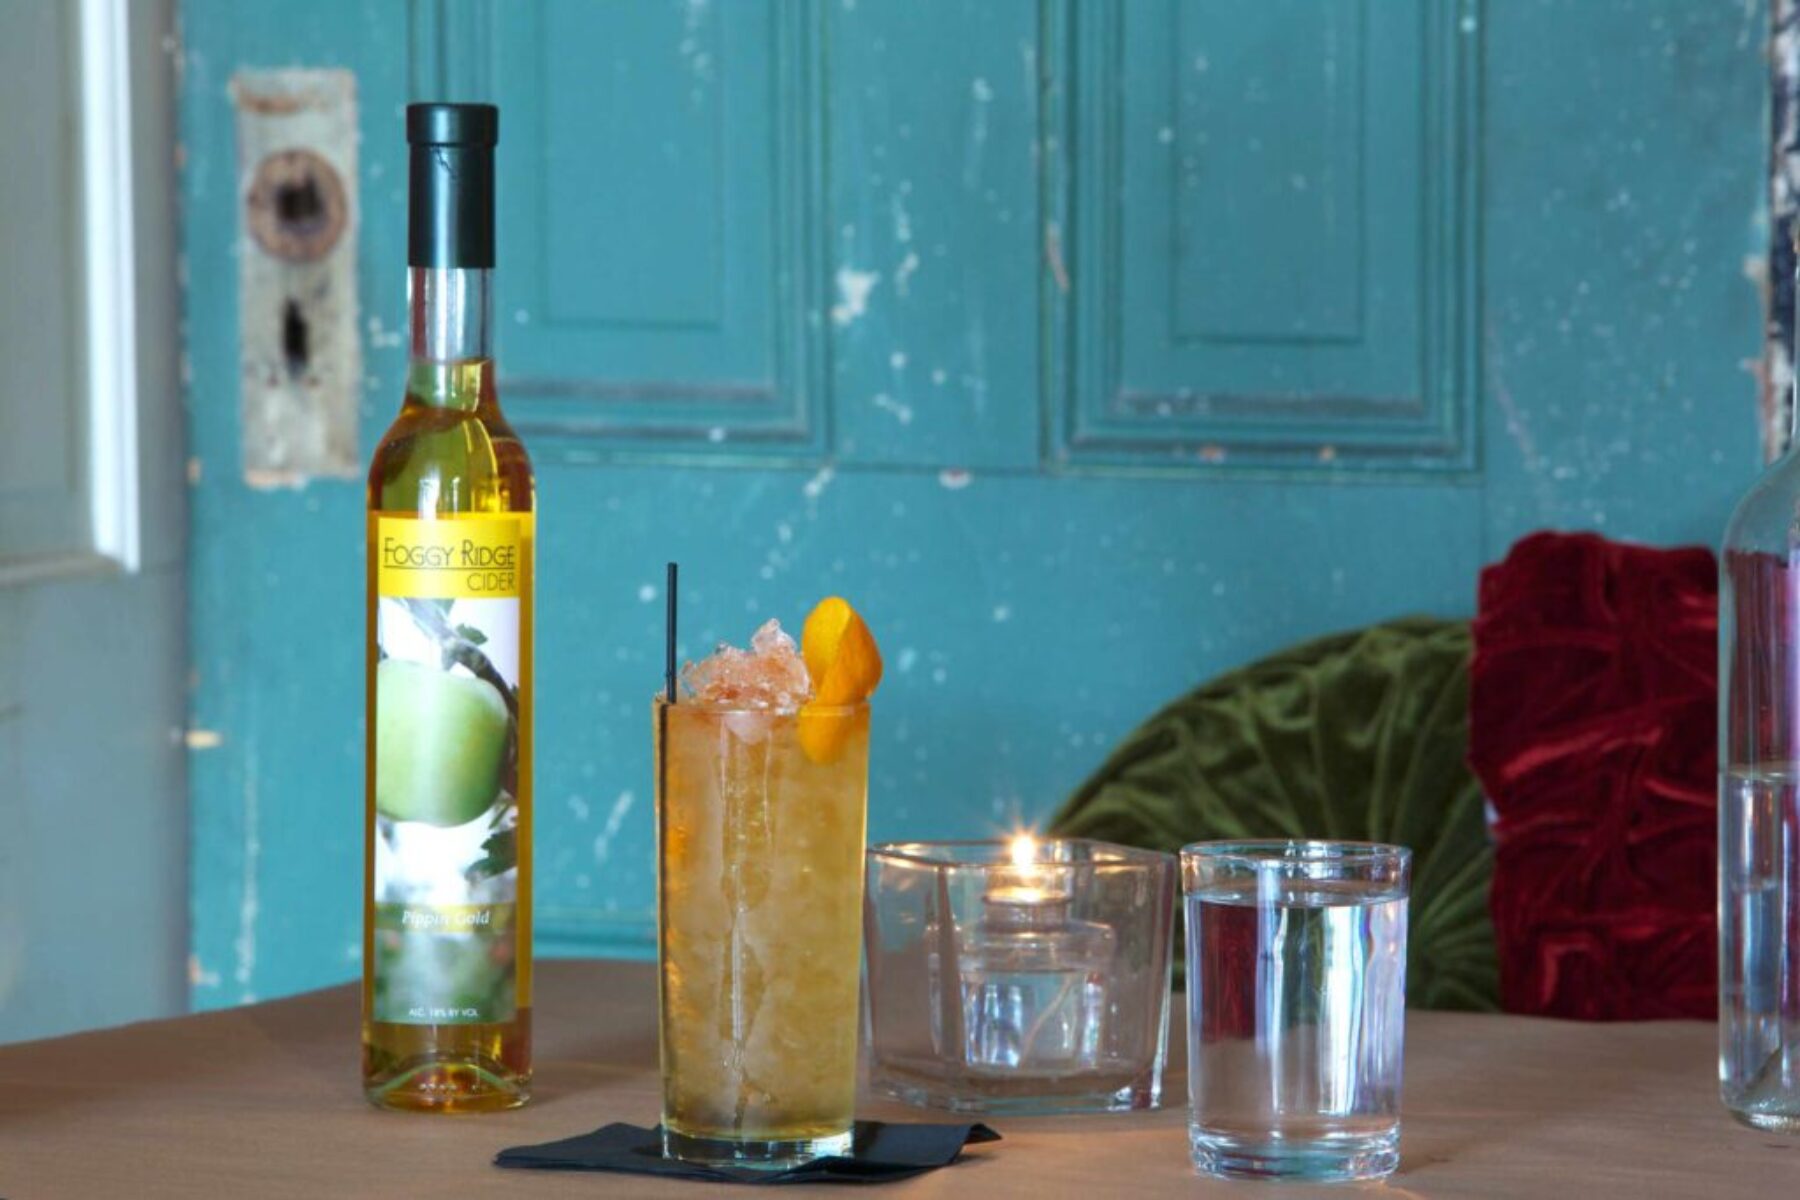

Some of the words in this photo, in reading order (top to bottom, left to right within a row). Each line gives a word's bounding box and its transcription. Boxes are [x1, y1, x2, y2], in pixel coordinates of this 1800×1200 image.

[384, 537, 454, 566] FOGGY
[462, 539, 515, 566] RIDGE
[467, 572, 515, 591] CIDER
[402, 910, 449, 928] Pippin
[455, 910, 490, 924] Gold
